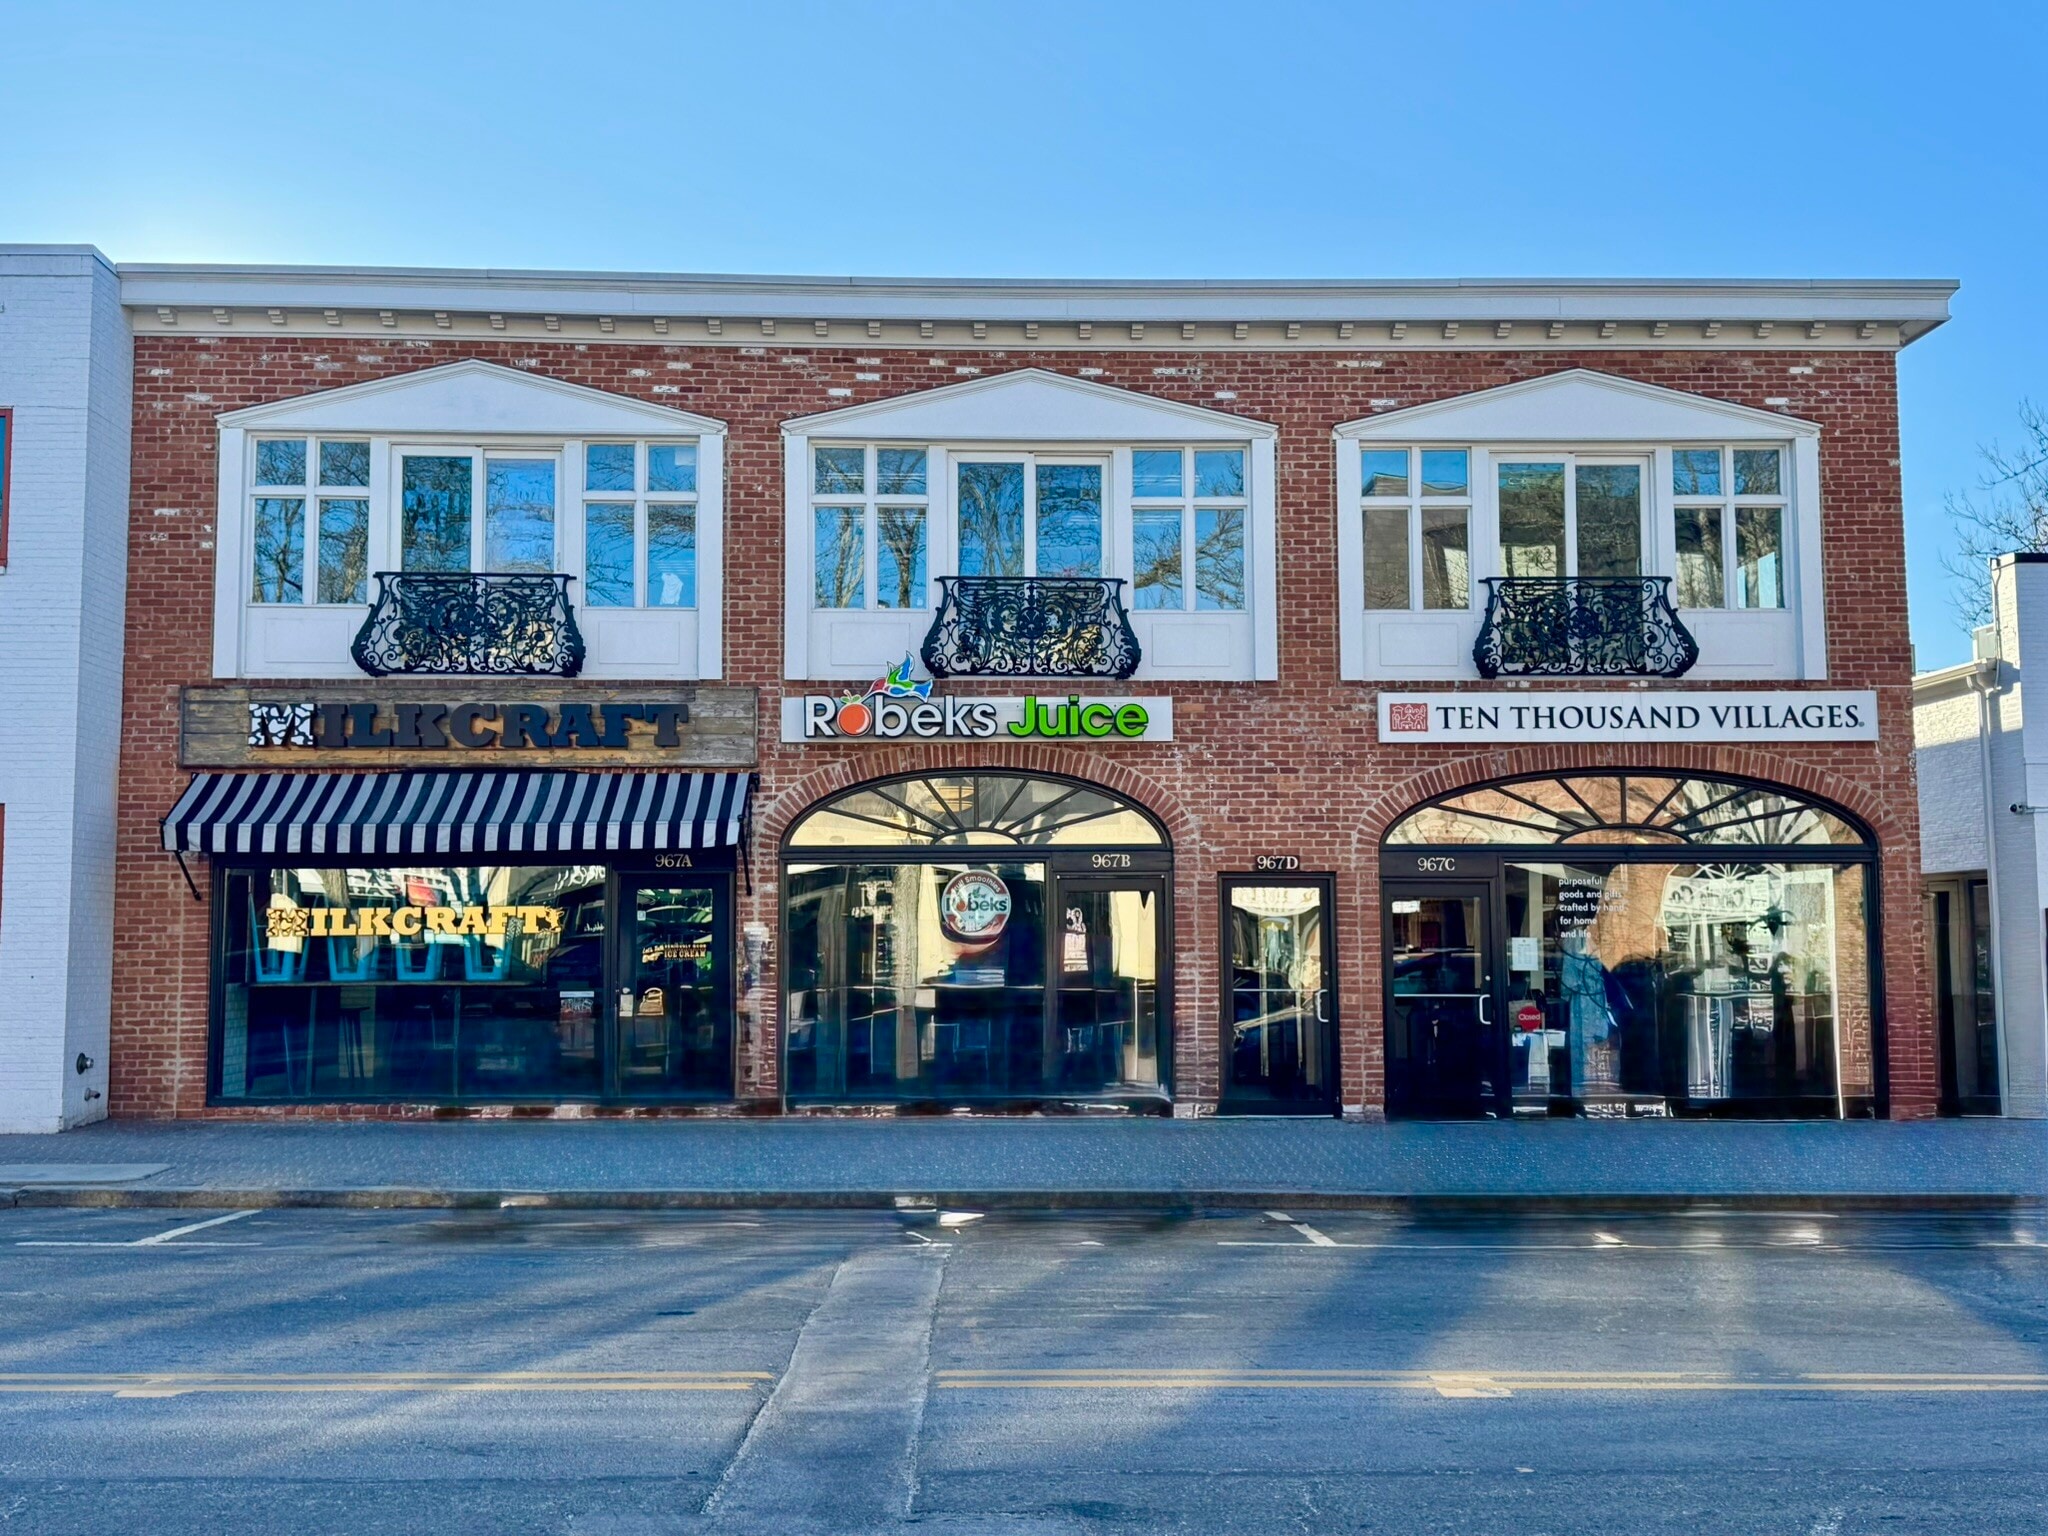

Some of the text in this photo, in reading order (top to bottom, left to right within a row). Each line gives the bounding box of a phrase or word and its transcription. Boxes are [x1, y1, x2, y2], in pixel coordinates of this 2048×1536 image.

[803, 694, 1150, 738] Robeks Juice
[1436, 705, 1500, 730] TEN
[1509, 705, 1700, 730] THOUSAND
[248, 702, 690, 748] MILKCRAFT
[654, 853, 693, 868] 967A
[1091, 854, 1131, 868] 967B
[1256, 855, 1299, 870] 967D
[1417, 857, 1456, 871] 967C
[964, 876, 1001, 893] Smoothies
[1558, 876, 1603, 887] purposeful
[1558, 889, 1584, 901] goods
[1586, 890, 1602, 899] and
[1559, 902, 1589, 912] crafted
[1590, 902, 1601, 914] by
[265, 906, 549, 937] MILKCRAFT
[1560, 915, 1598, 925] for home
[1560, 929, 1592, 938] and life
[664, 950, 706, 958] ICE CREAM
[1518, 1013, 1541, 1021] Closed
